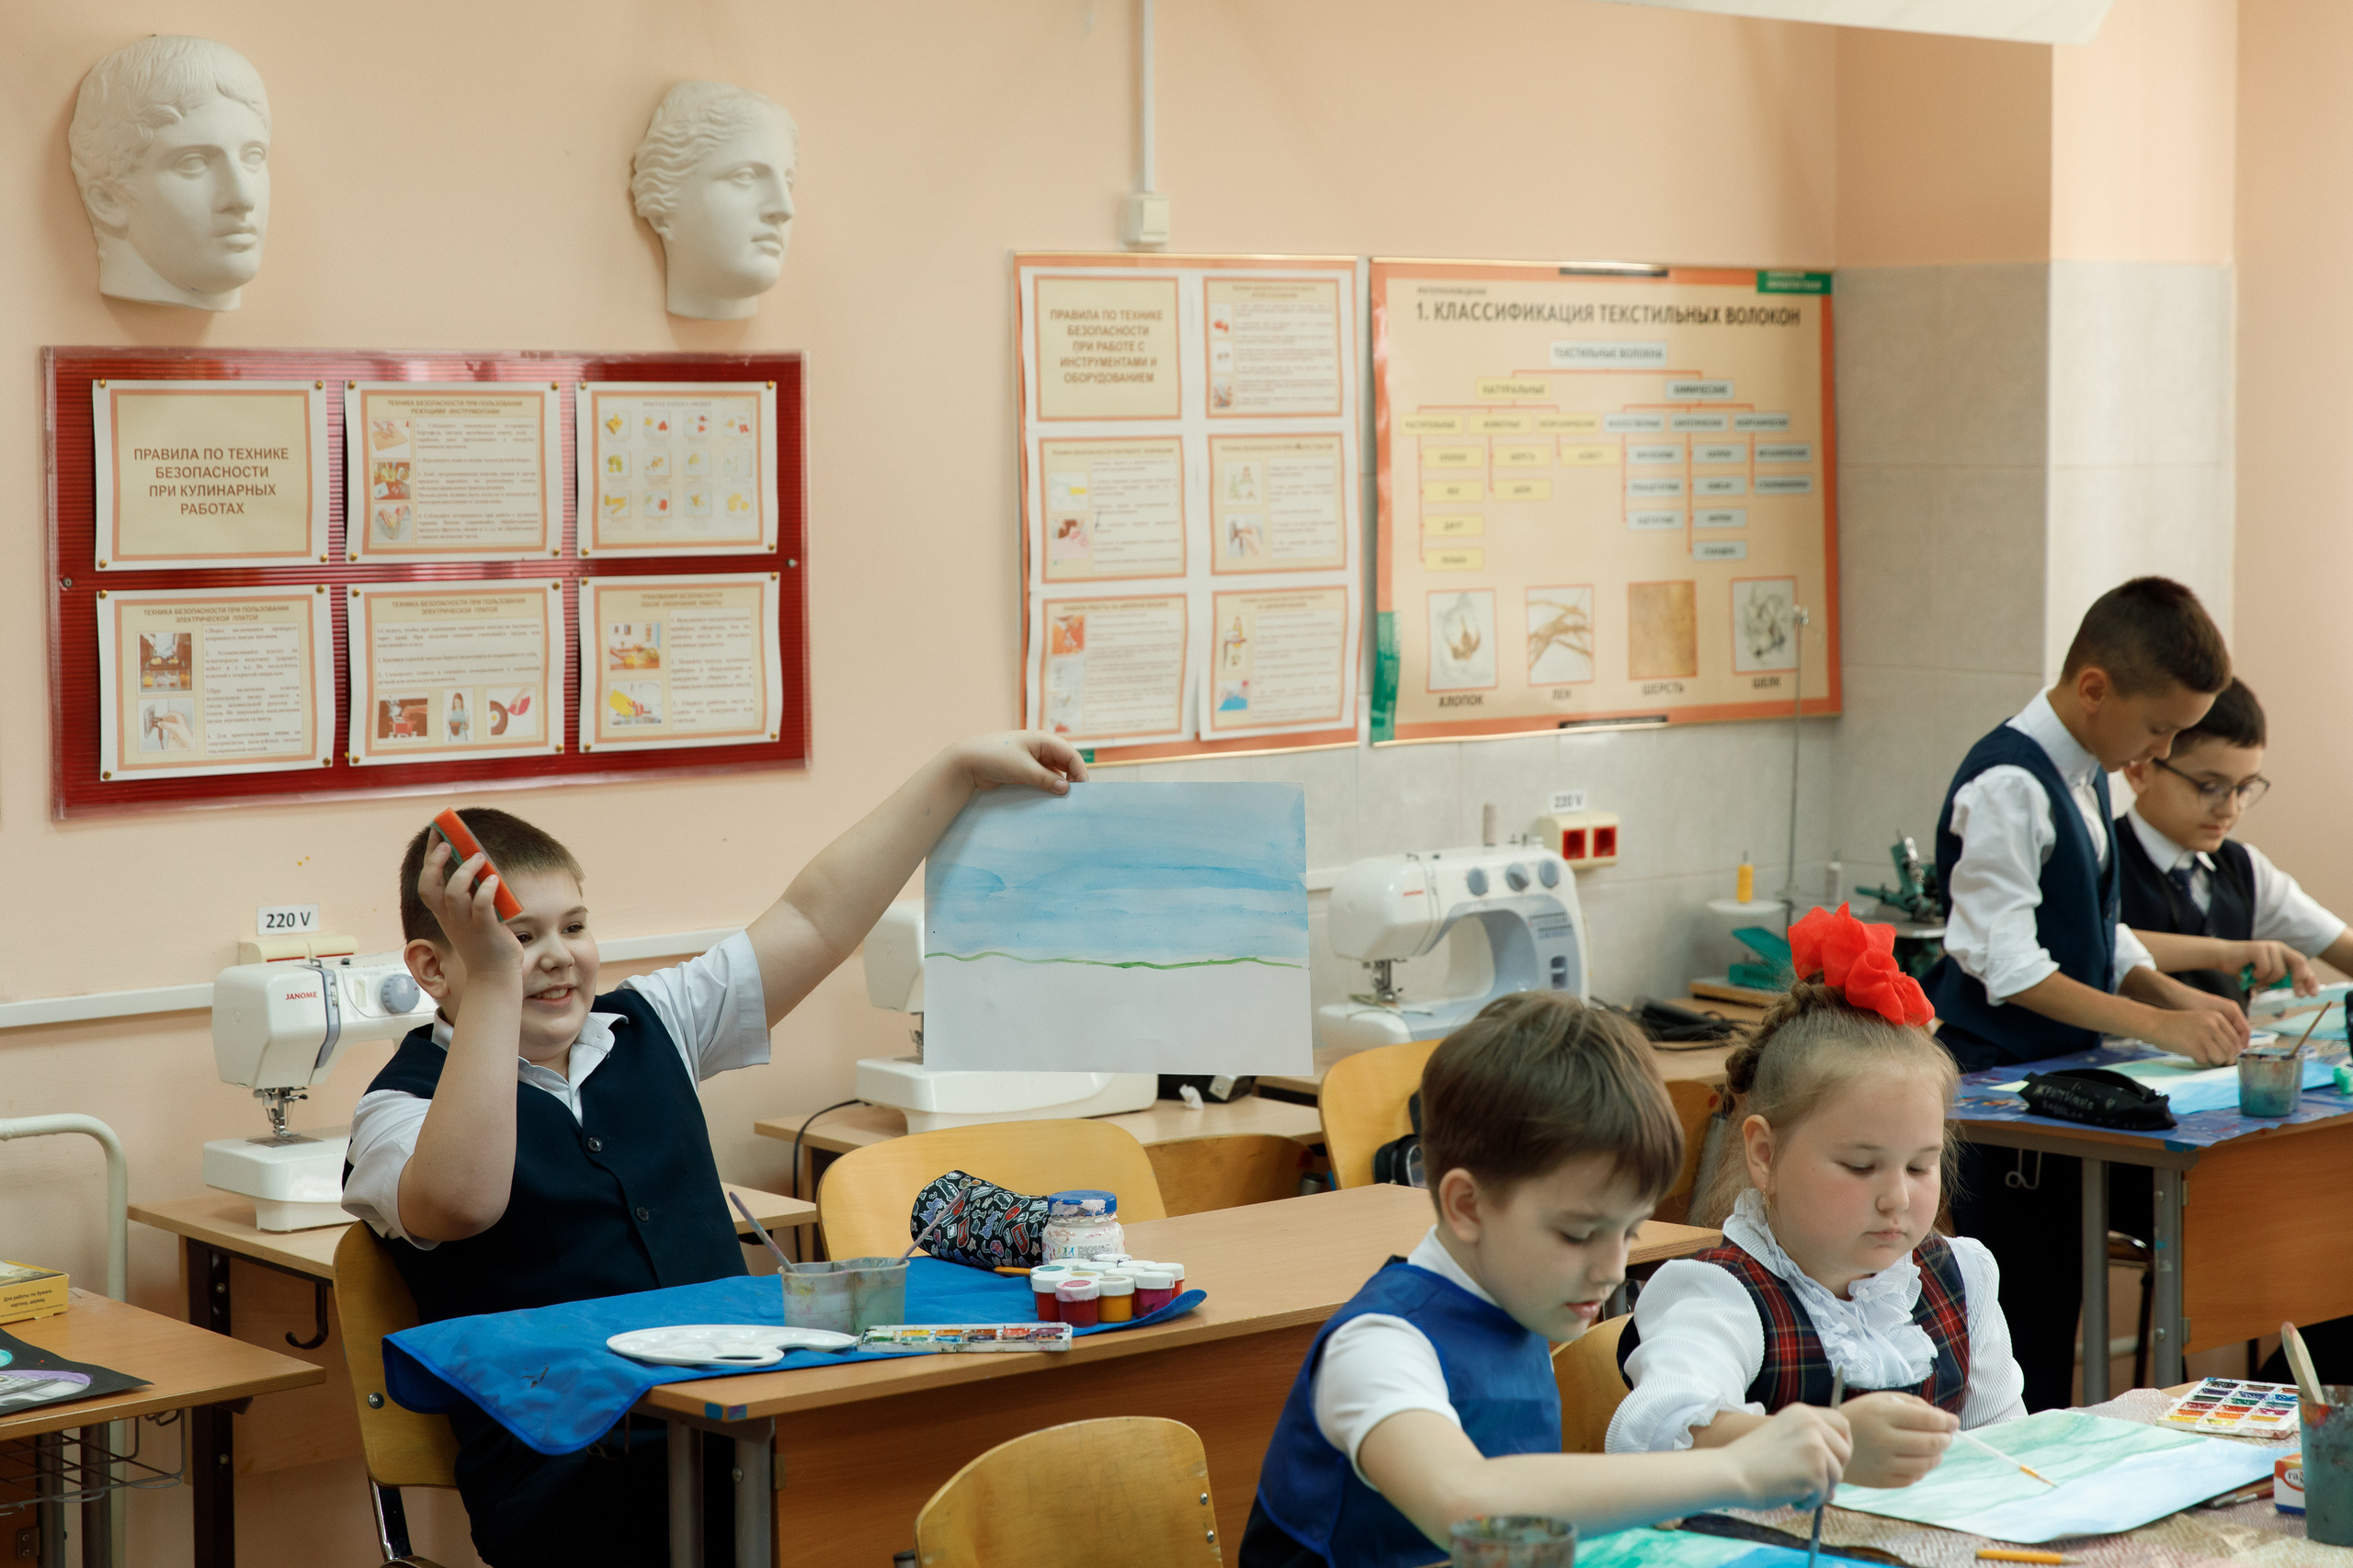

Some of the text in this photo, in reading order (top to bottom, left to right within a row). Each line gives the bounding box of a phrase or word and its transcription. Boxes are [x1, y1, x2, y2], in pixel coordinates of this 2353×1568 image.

[1050, 309, 1163, 321] ПРАВИЛА ПО ТЕХНИКЕ
[1416, 301, 1802, 325] 1. КЛАССИФИКАЦИЯ ТЕКСТИЛЬНЫХ ВОЛОКОН
[1067, 324, 1150, 336] БЕЗОПАСНОСТИ
[1073, 341, 1145, 352] ПРИ РАБОТЕ С
[1060, 357, 1158, 368] ИНСТРУМЕНТАМИ И
[1063, 372, 1154, 383] ОБОРУДОВАНИЕМ
[134, 448, 289, 460] ПРАВИЛА ПО ТЕХНИКЕ
[155, 466, 268, 479] БЕЗОПАСНОСТИ
[149, 483, 277, 497] ПРИ КУЛИНАРНЫХ
[180, 503, 244, 515] РАБОТАХ
[176, 615, 229, 623] ЭЛЕКТРИЧЕСКОЙ
[1643, 682, 1685, 695] ШЕРСТЬ
[1553, 793, 1584, 809] 220 V
[266, 912, 312, 928] 220 V
[285, 992, 318, 1000] JANOME
